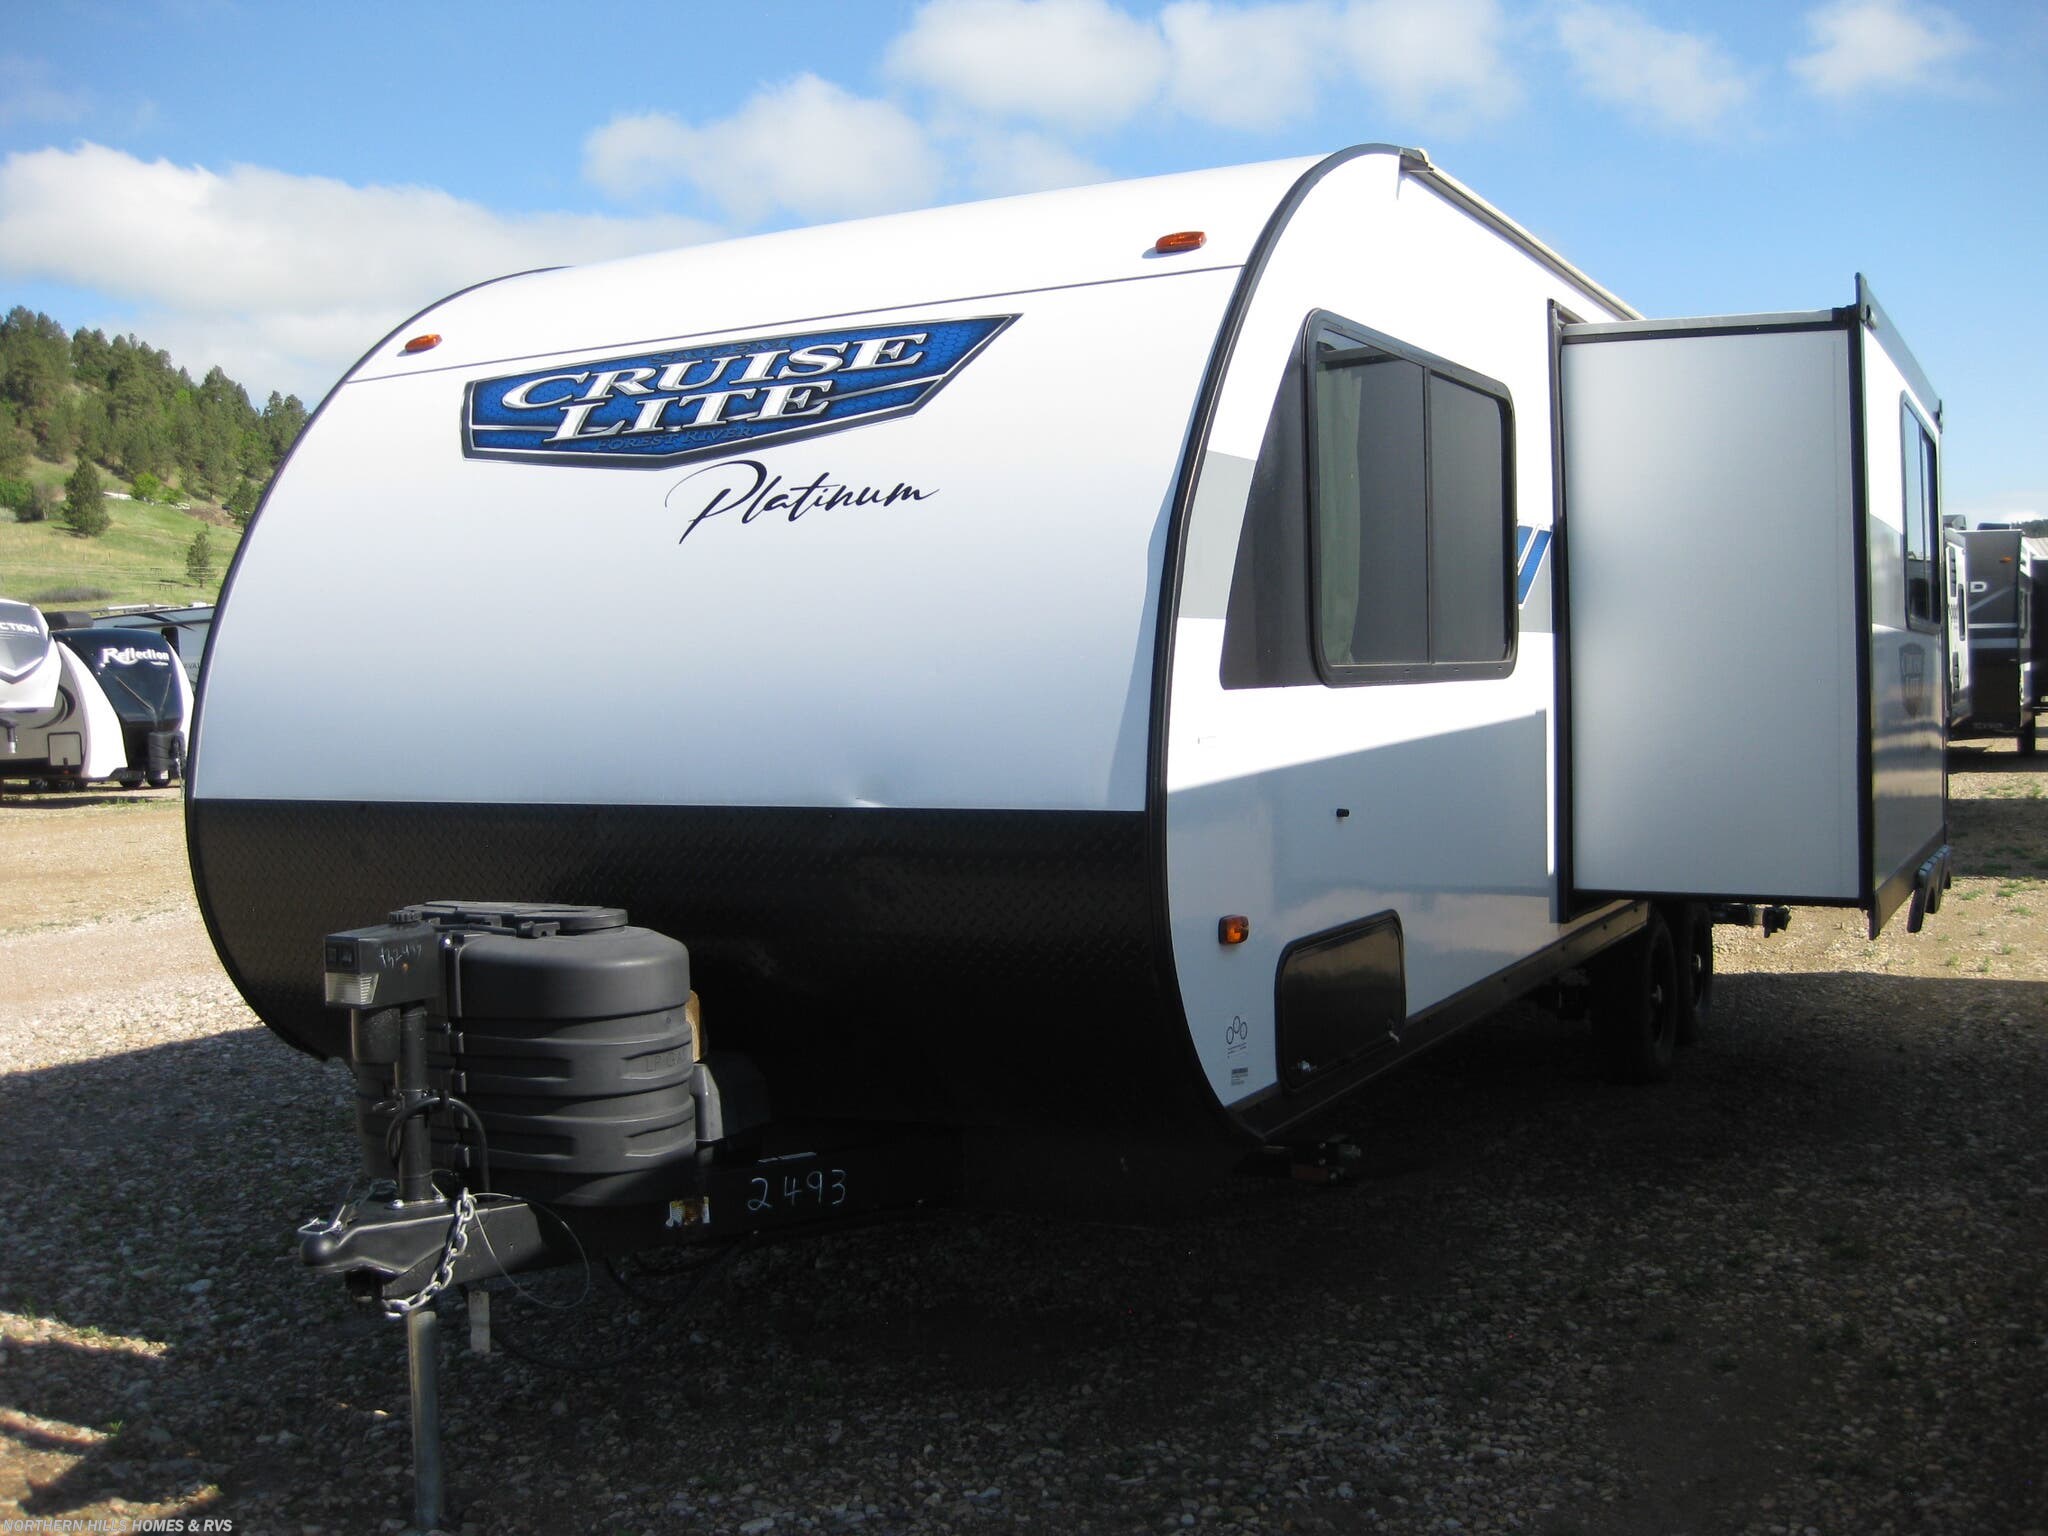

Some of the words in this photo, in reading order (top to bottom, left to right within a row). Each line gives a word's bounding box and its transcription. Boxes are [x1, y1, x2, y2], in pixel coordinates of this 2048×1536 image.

[502, 333, 929, 411] CRUISE
[544, 379, 833, 444] LITE
[594, 432, 679, 451] FOREST
[681, 425, 753, 444] RIVER
[665, 459, 941, 545] Platinum
[101, 647, 170, 665] Reflection
[747, 1169, 846, 1210] 2493
